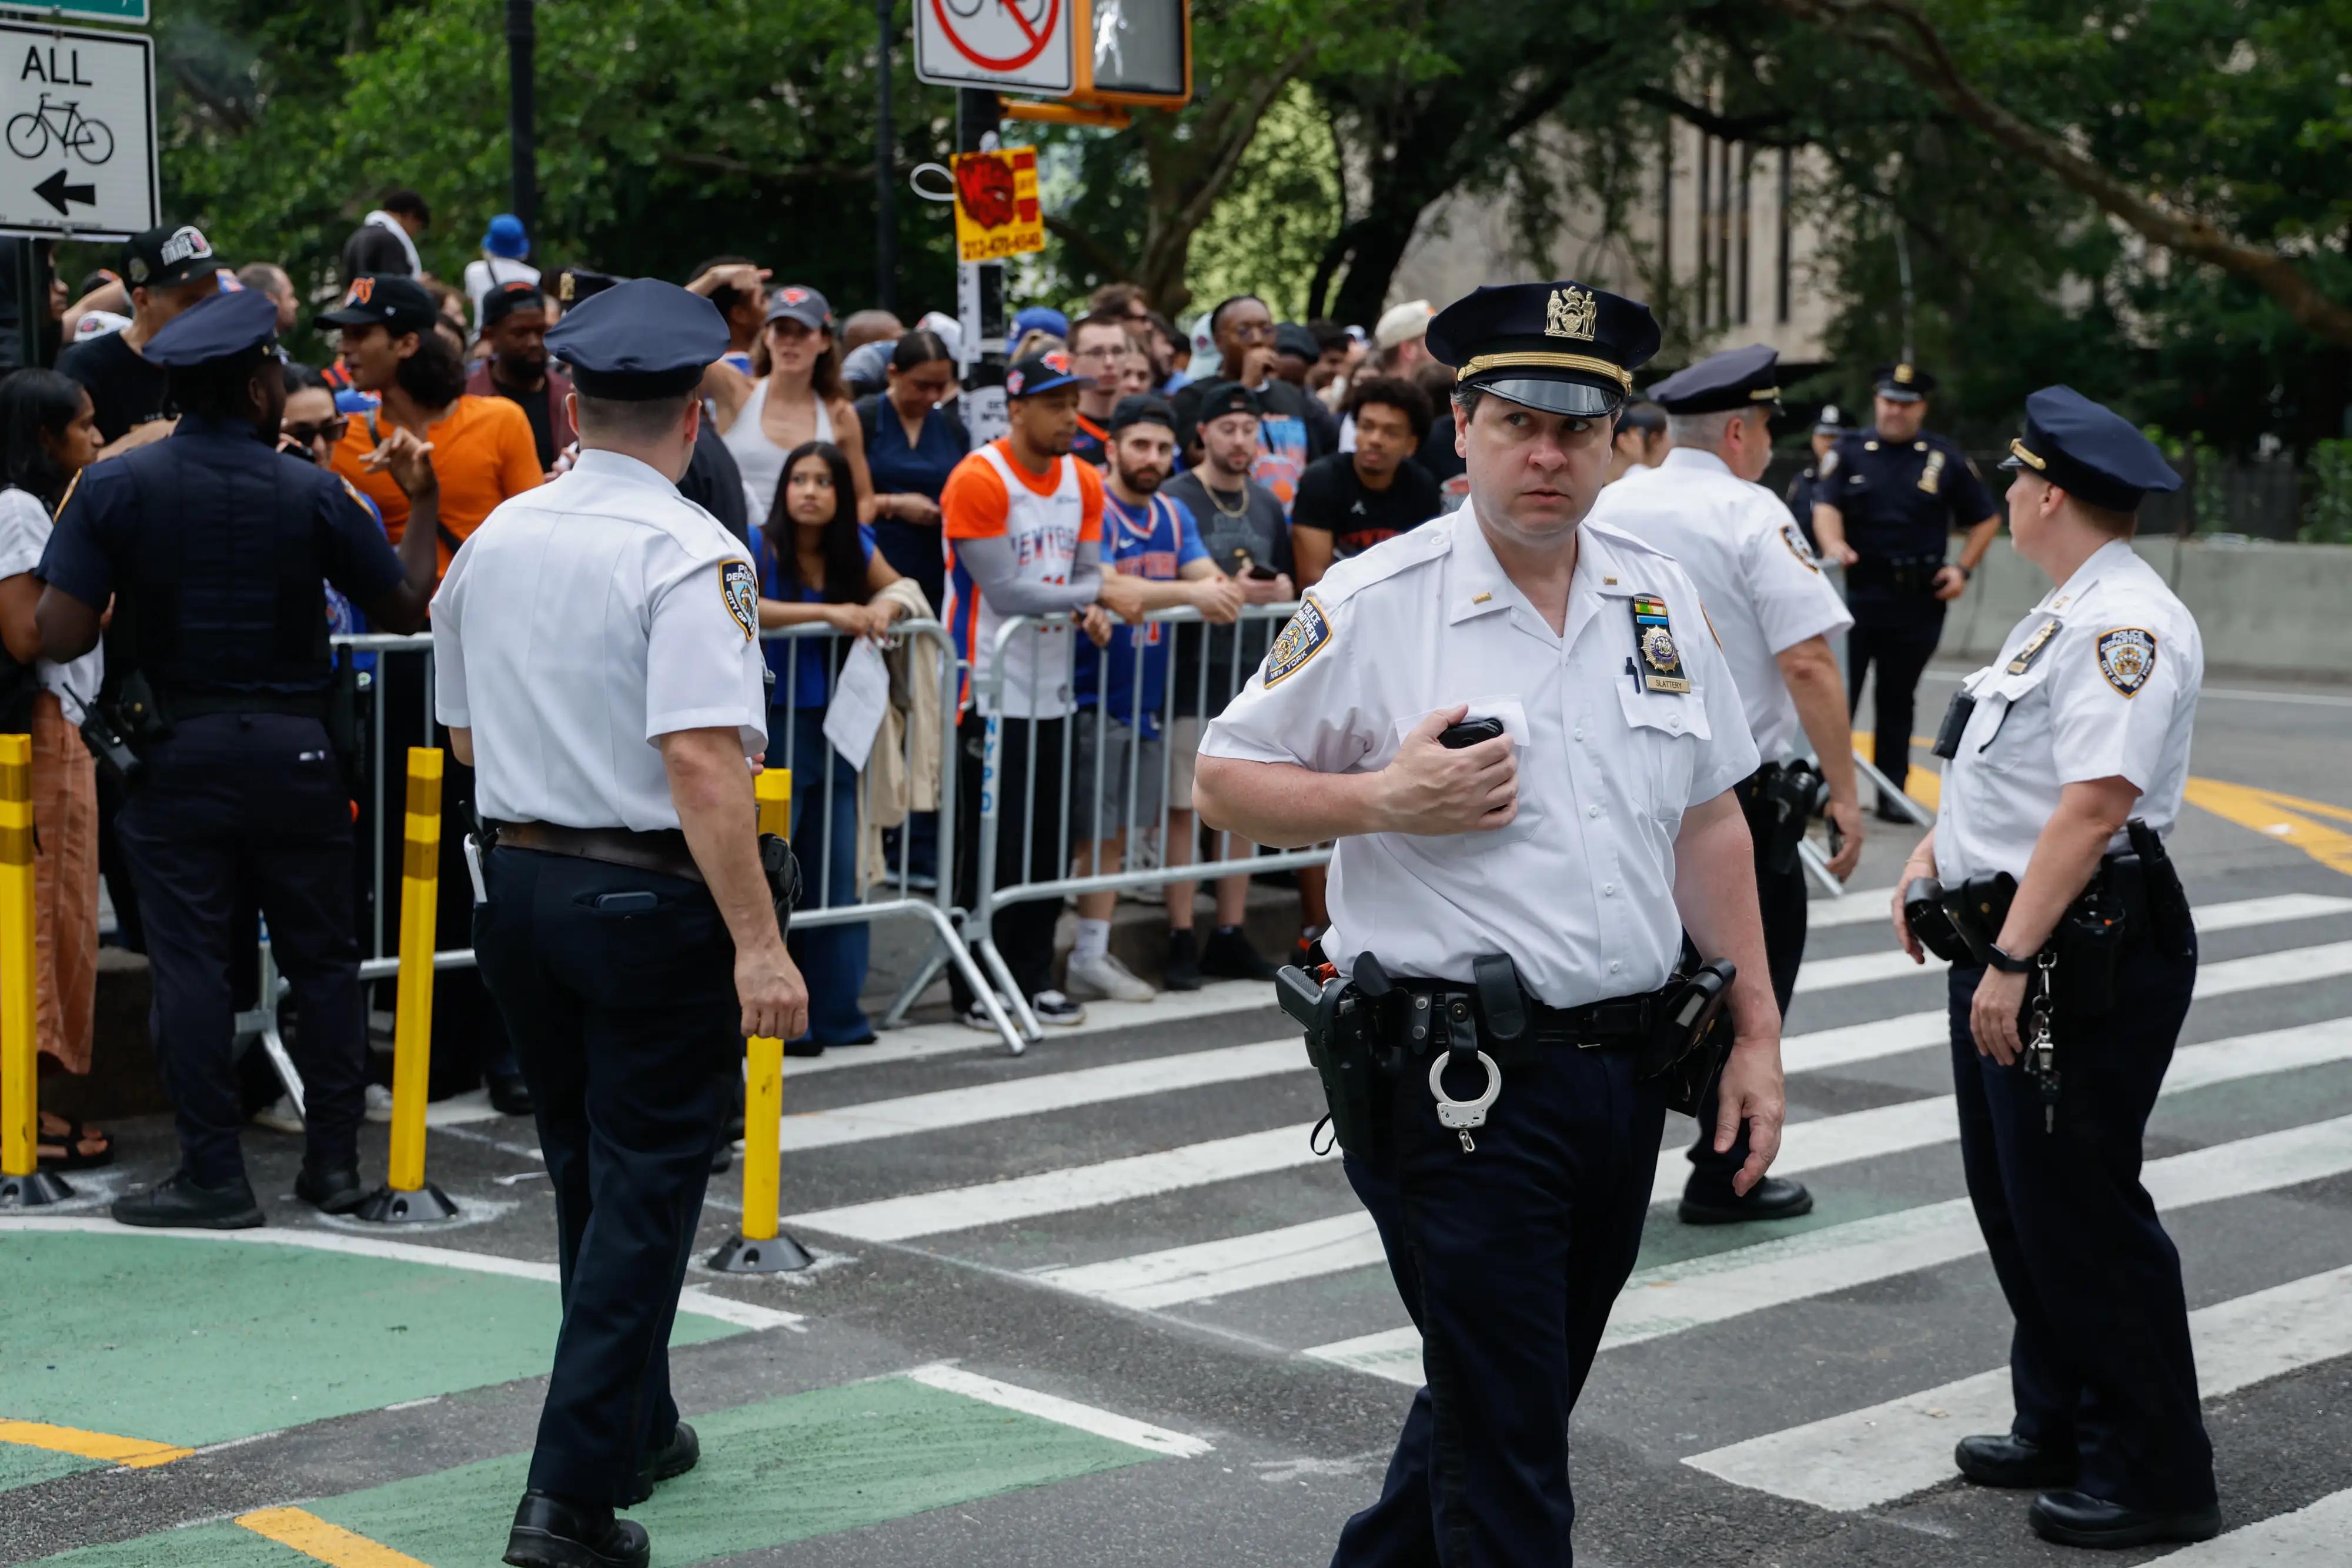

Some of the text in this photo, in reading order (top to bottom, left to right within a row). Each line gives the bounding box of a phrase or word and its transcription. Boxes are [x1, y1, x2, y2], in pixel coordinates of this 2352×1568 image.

[21, 45, 92, 86] ALL
[726, 590, 748, 624] CITY OF
[1304, 602, 1321, 627] POLICE
[2112, 630, 2145, 640] POLICE
[1270, 650, 1308, 680] NEW YORK
[1656, 680, 1682, 689] SLATTERY
[981, 716, 995, 813] NYPD
